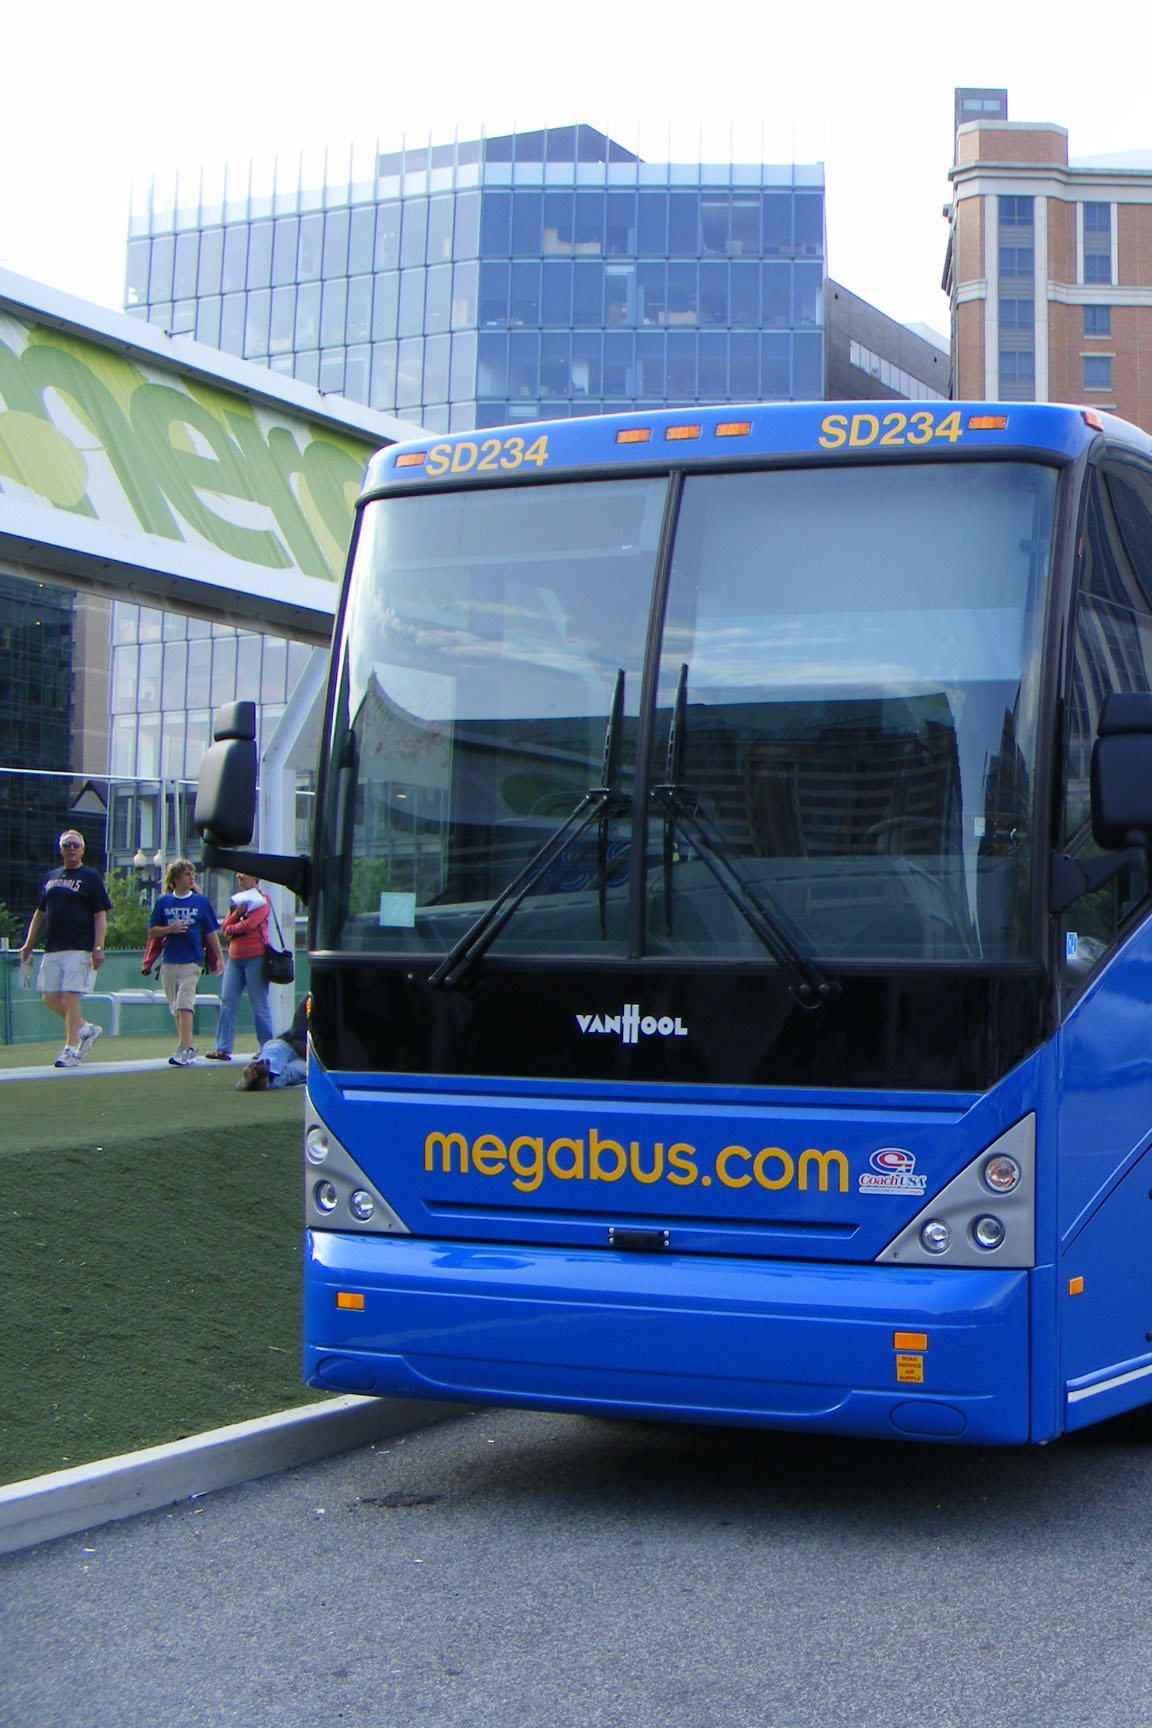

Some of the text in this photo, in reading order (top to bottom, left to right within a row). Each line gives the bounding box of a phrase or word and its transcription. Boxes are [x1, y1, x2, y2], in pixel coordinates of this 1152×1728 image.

[818, 411, 964, 449] SD234
[425, 435, 548, 476] SD234
[164, 907, 199, 917] BATTLE
[424, 1129, 849, 1193] megabus.com
[860, 1174, 926, 1188] Coach USA
